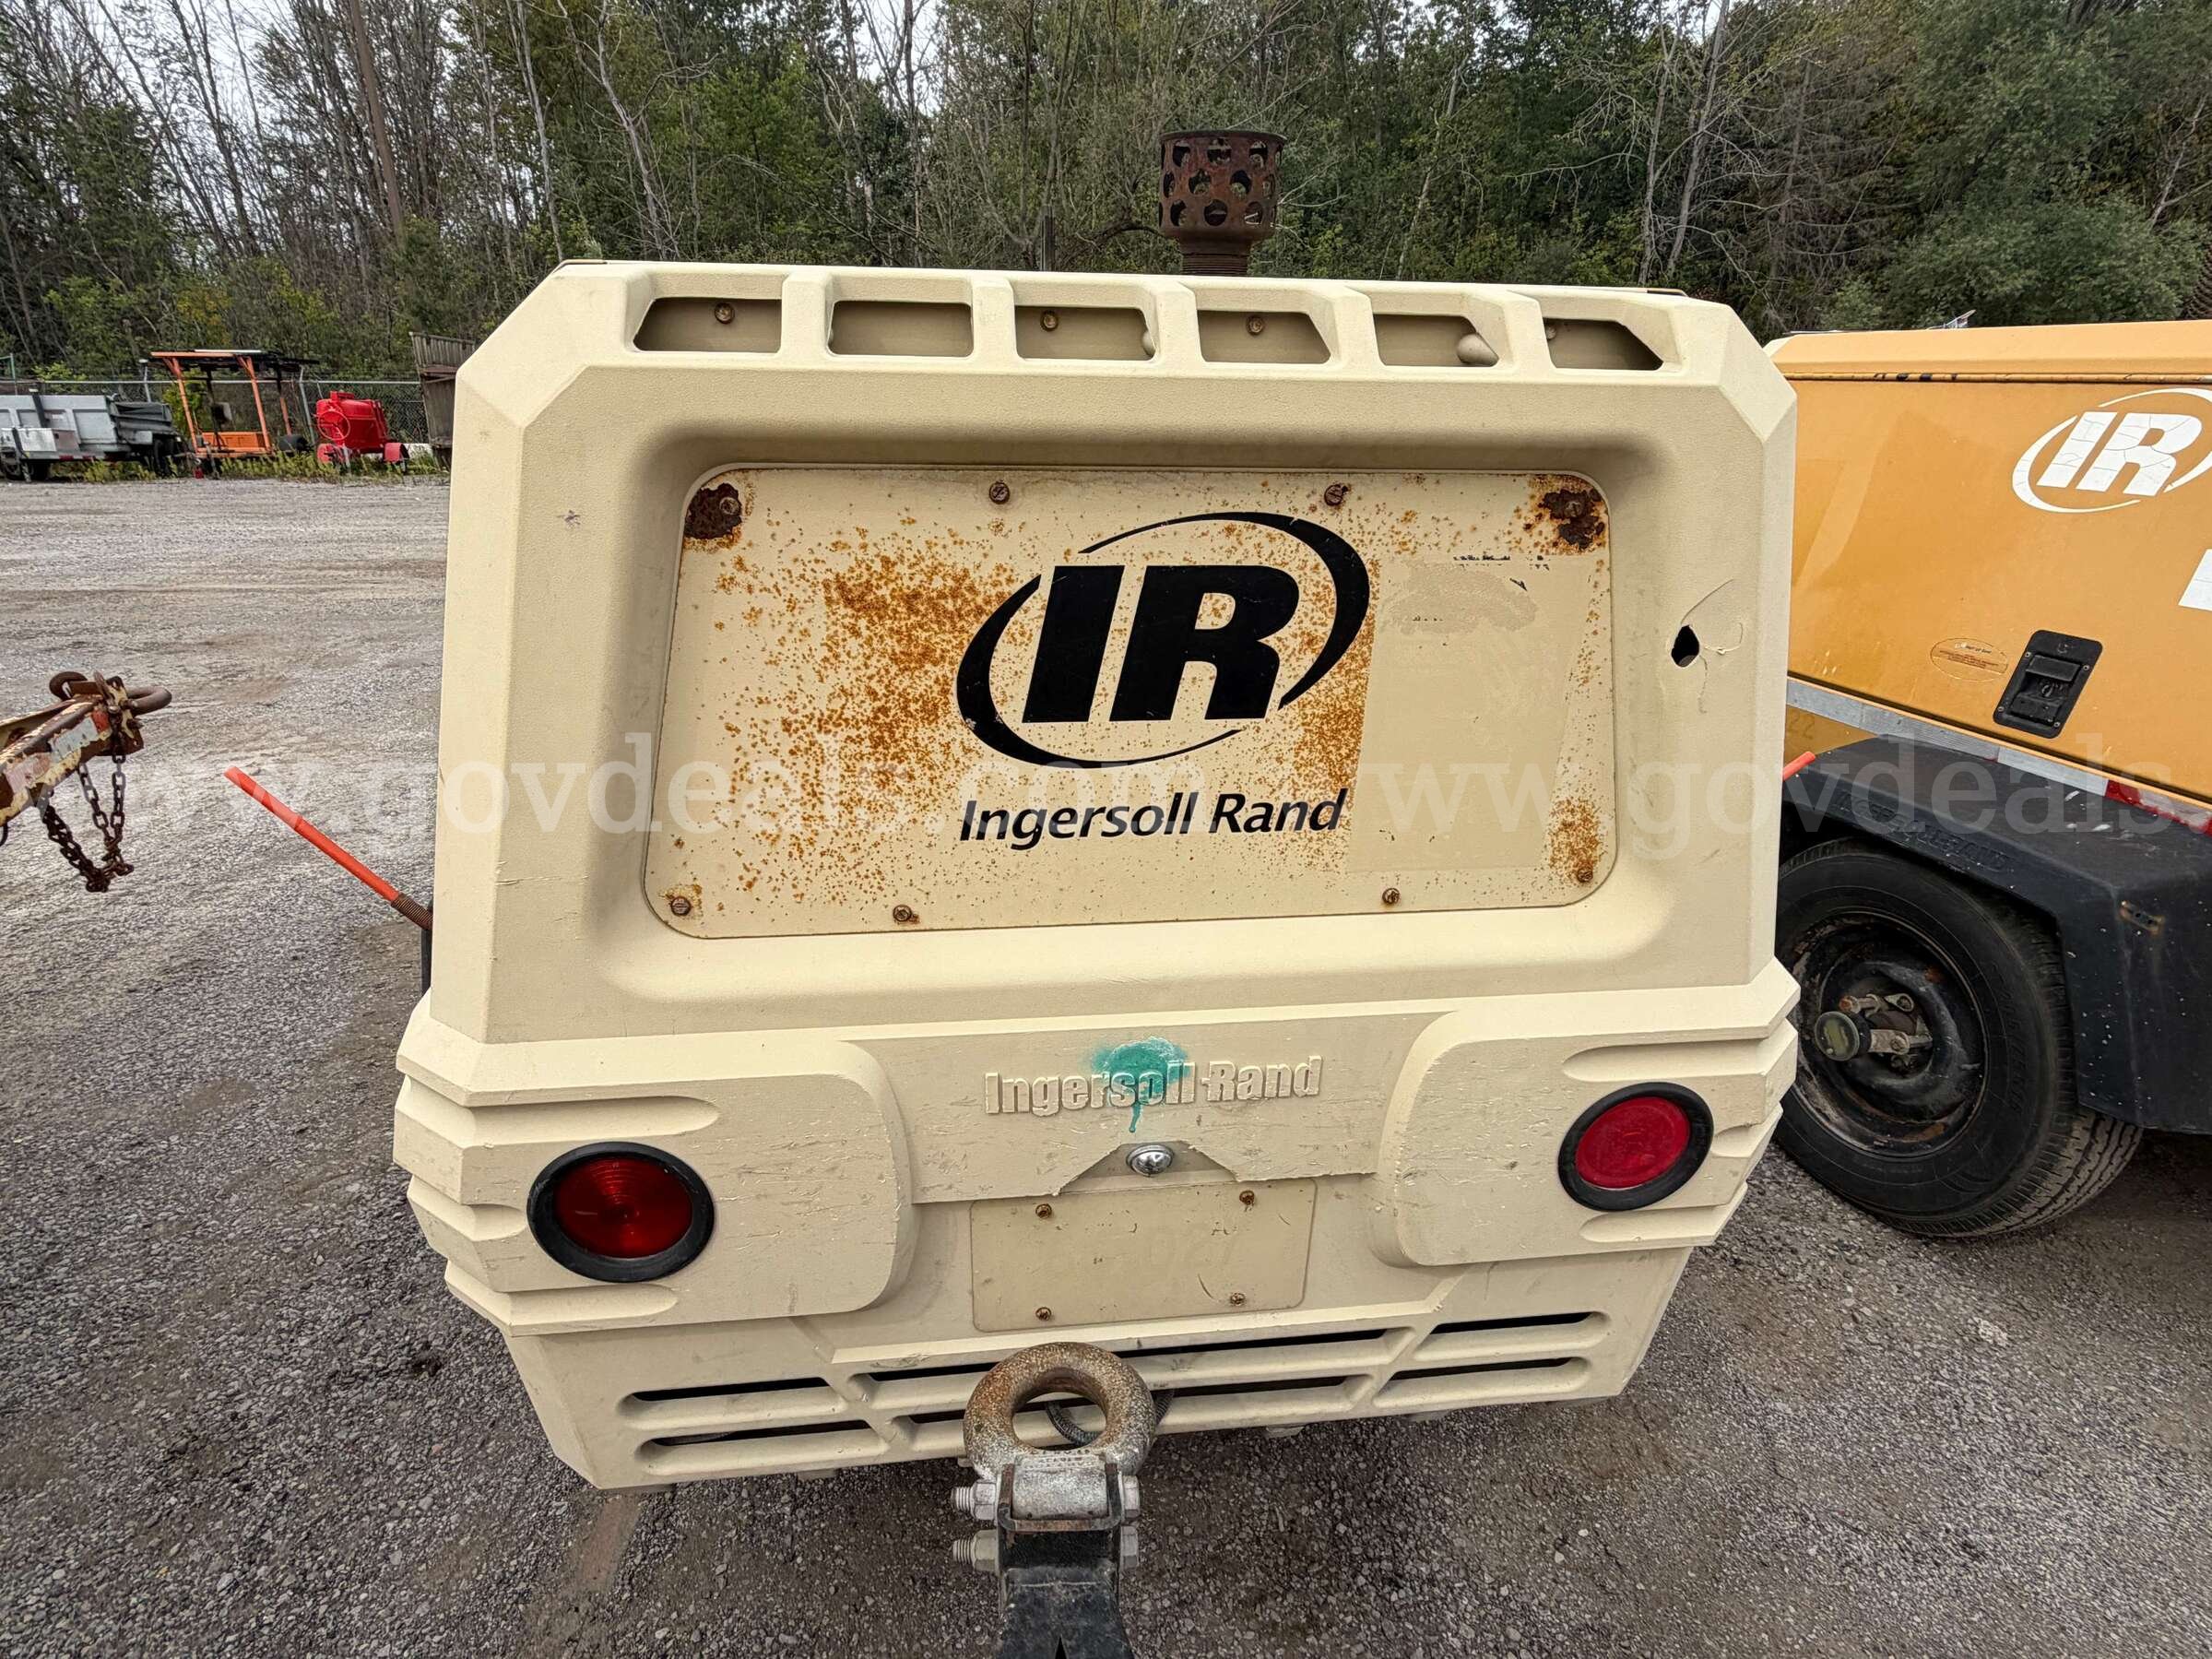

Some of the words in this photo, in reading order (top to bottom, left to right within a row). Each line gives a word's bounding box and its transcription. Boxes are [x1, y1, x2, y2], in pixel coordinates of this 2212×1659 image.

[2036, 410, 2203, 498] IR
[1022, 564, 1300, 723] IR
[959, 791, 1201, 850] Ingersoll
[1209, 788, 1347, 835] Rand
[984, 1055, 1323, 1118] Ingersoll-Rand
